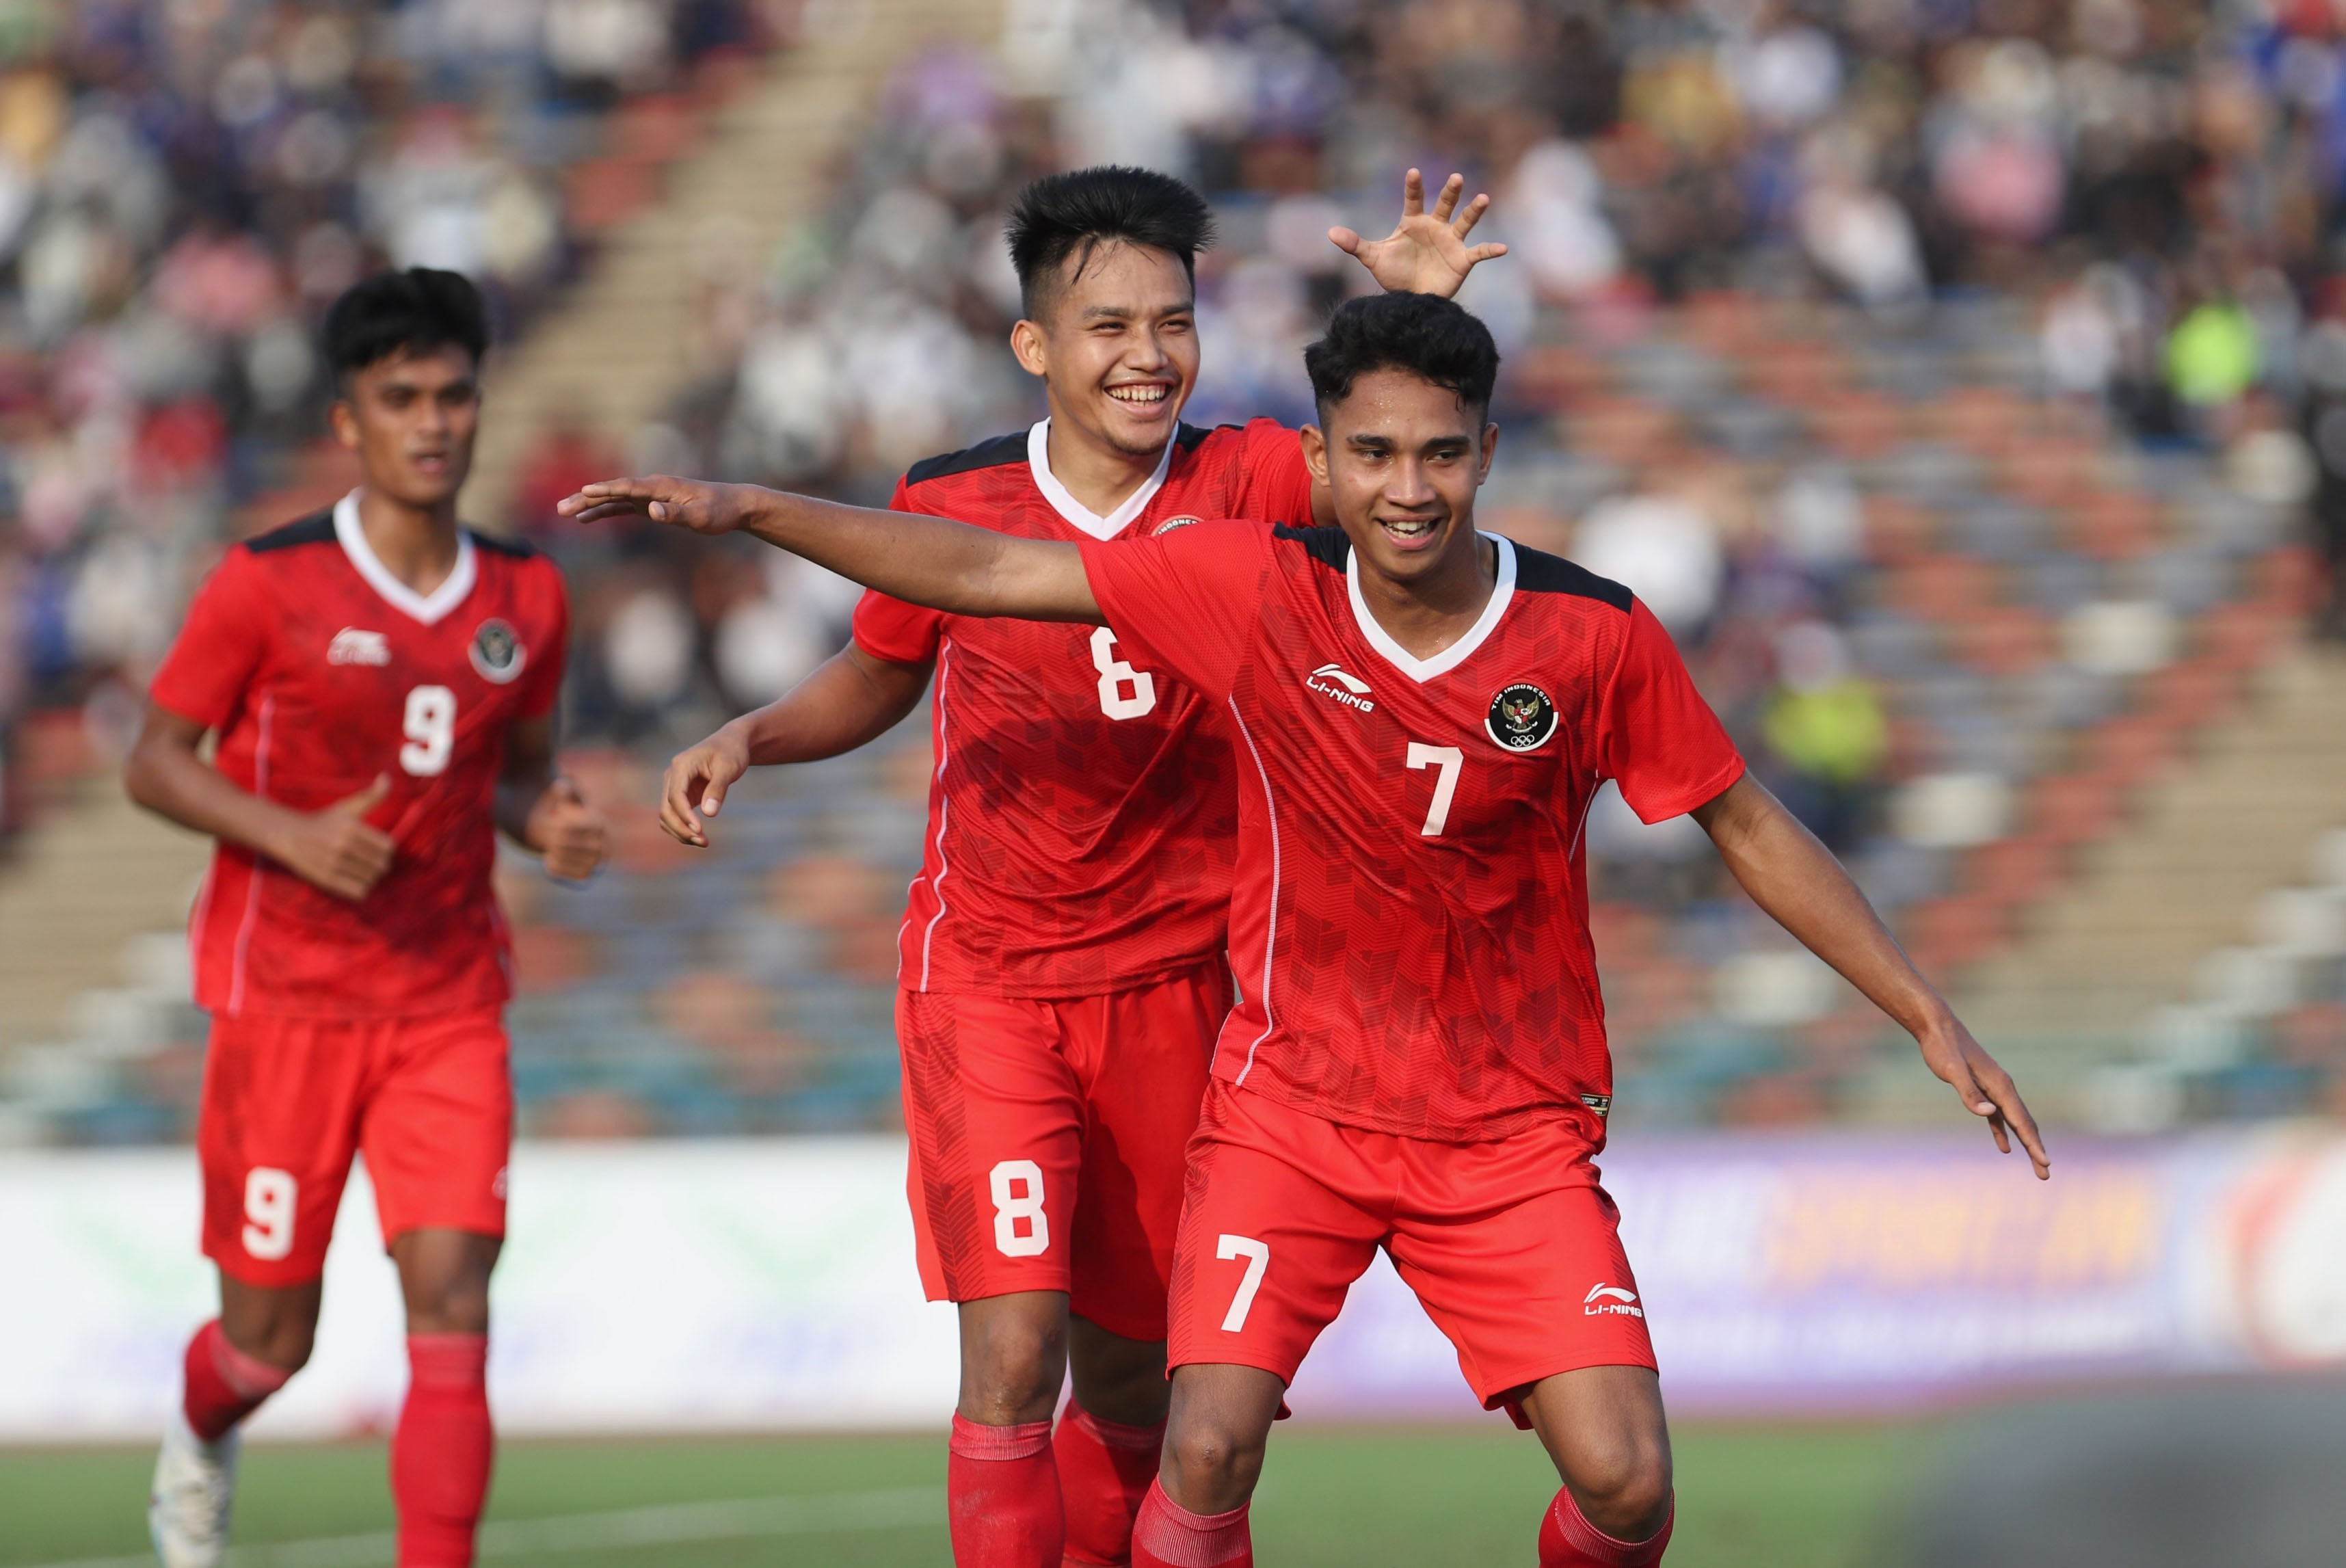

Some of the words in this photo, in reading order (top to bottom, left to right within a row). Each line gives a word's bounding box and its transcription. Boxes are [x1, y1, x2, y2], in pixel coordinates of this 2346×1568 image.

[400, 685, 456, 776] 9
[1306, 676, 1374, 712] LI-NING
[1491, 693, 1504, 710] TIM
[1504, 684, 1551, 706] INDONESIA
[1406, 741, 1464, 836] 7
[243, 1167, 297, 1260] 9
[989, 1159, 1050, 1258] 8
[1216, 1234, 1270, 1333] 7
[1584, 1304, 1642, 1318] LI-NING
